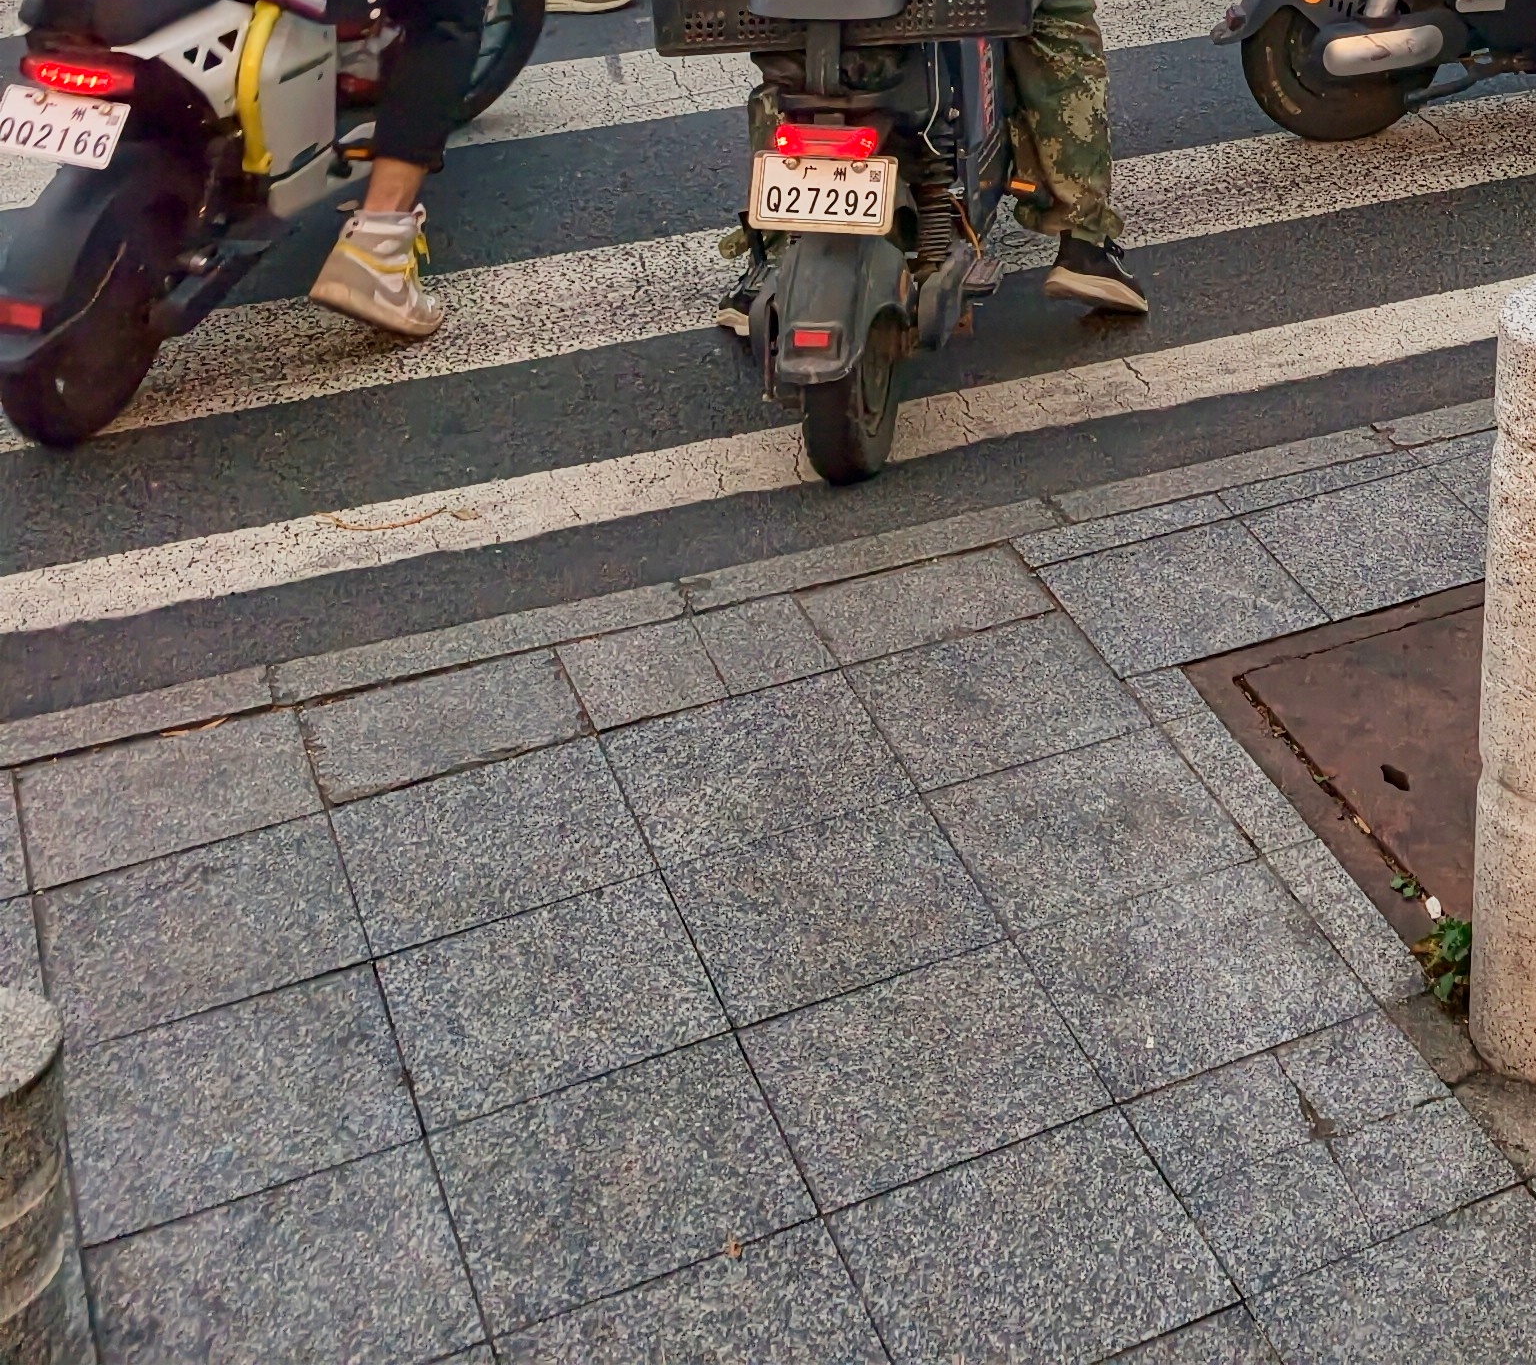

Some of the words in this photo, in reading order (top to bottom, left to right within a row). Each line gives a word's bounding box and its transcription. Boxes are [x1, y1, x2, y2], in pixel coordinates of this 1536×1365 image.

[40, 101, 88, 122] 广州
[802, 165, 847, 182] 广州
[766, 185, 878, 218] Q27292
